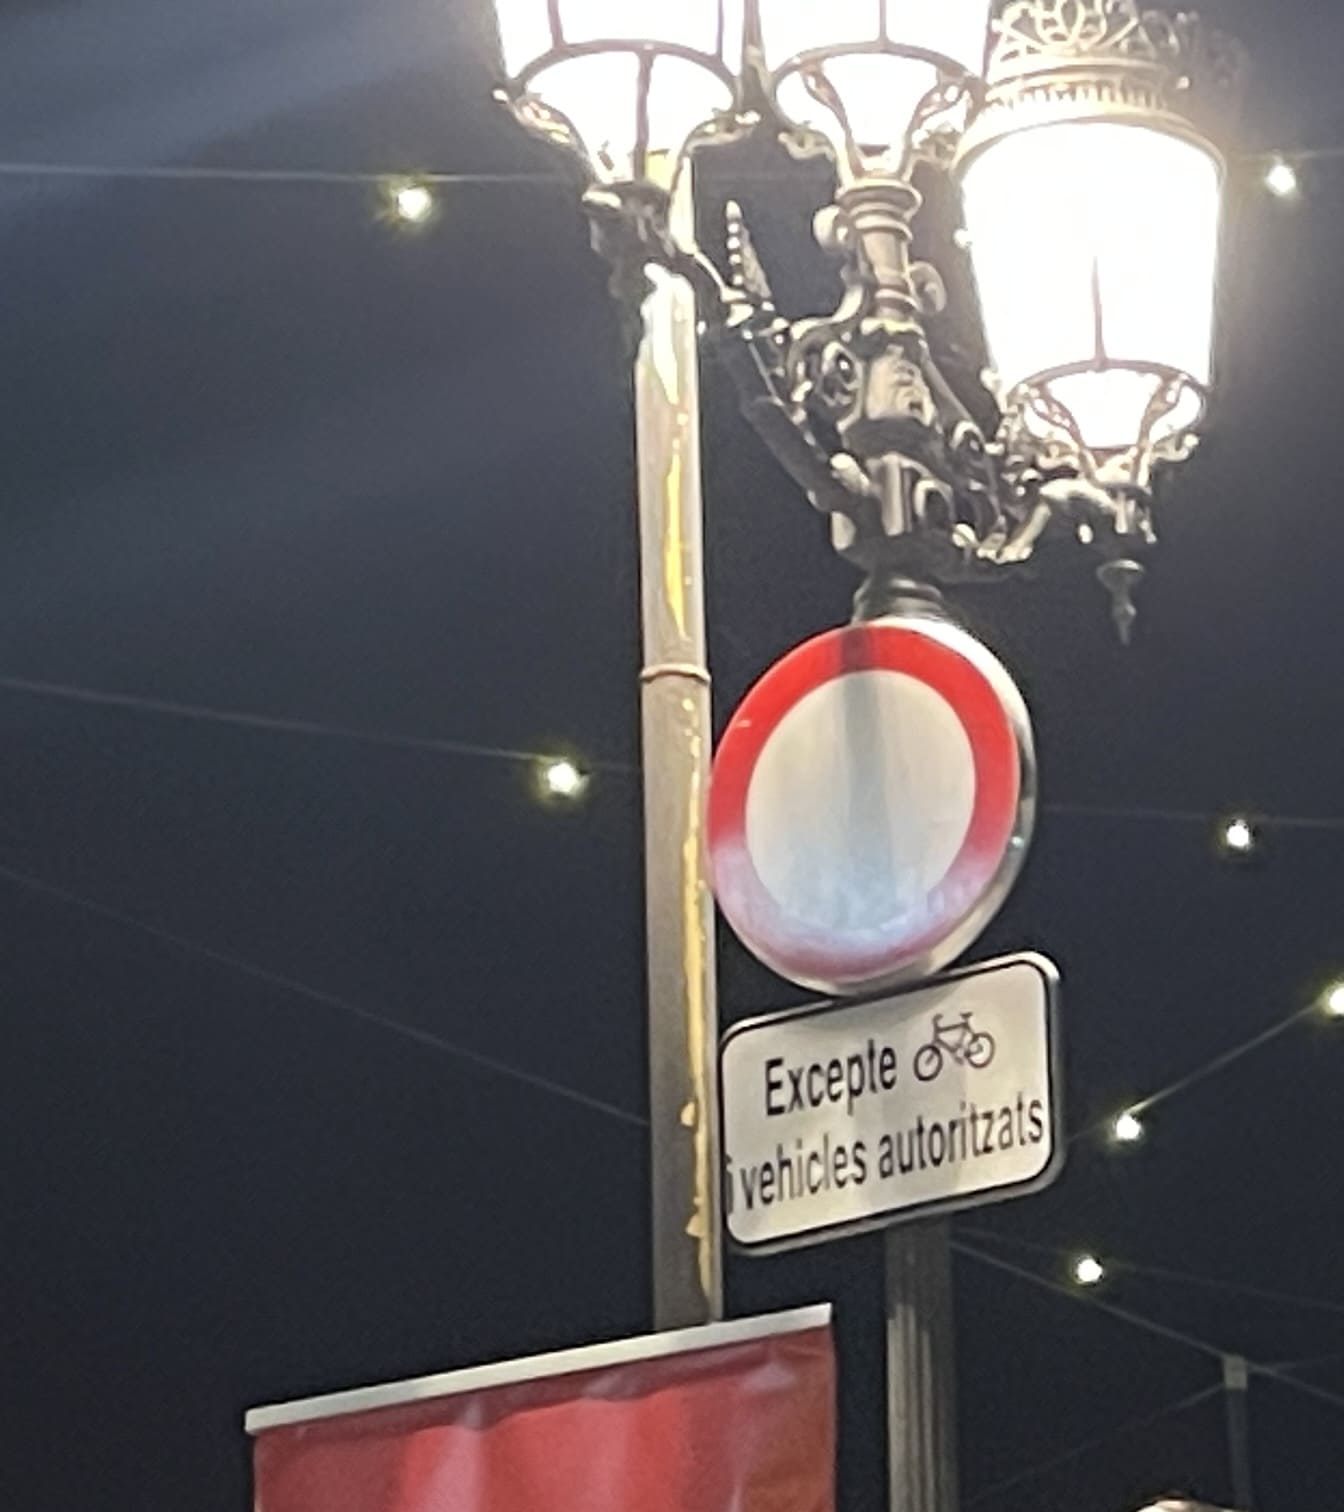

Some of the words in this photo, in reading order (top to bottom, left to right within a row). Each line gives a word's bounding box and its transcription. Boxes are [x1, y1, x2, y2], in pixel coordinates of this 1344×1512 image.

[765, 1039, 898, 1116] Excepte
[740, 1132, 867, 1210] vehicles
[878, 1091, 1044, 1178] autoritzats
